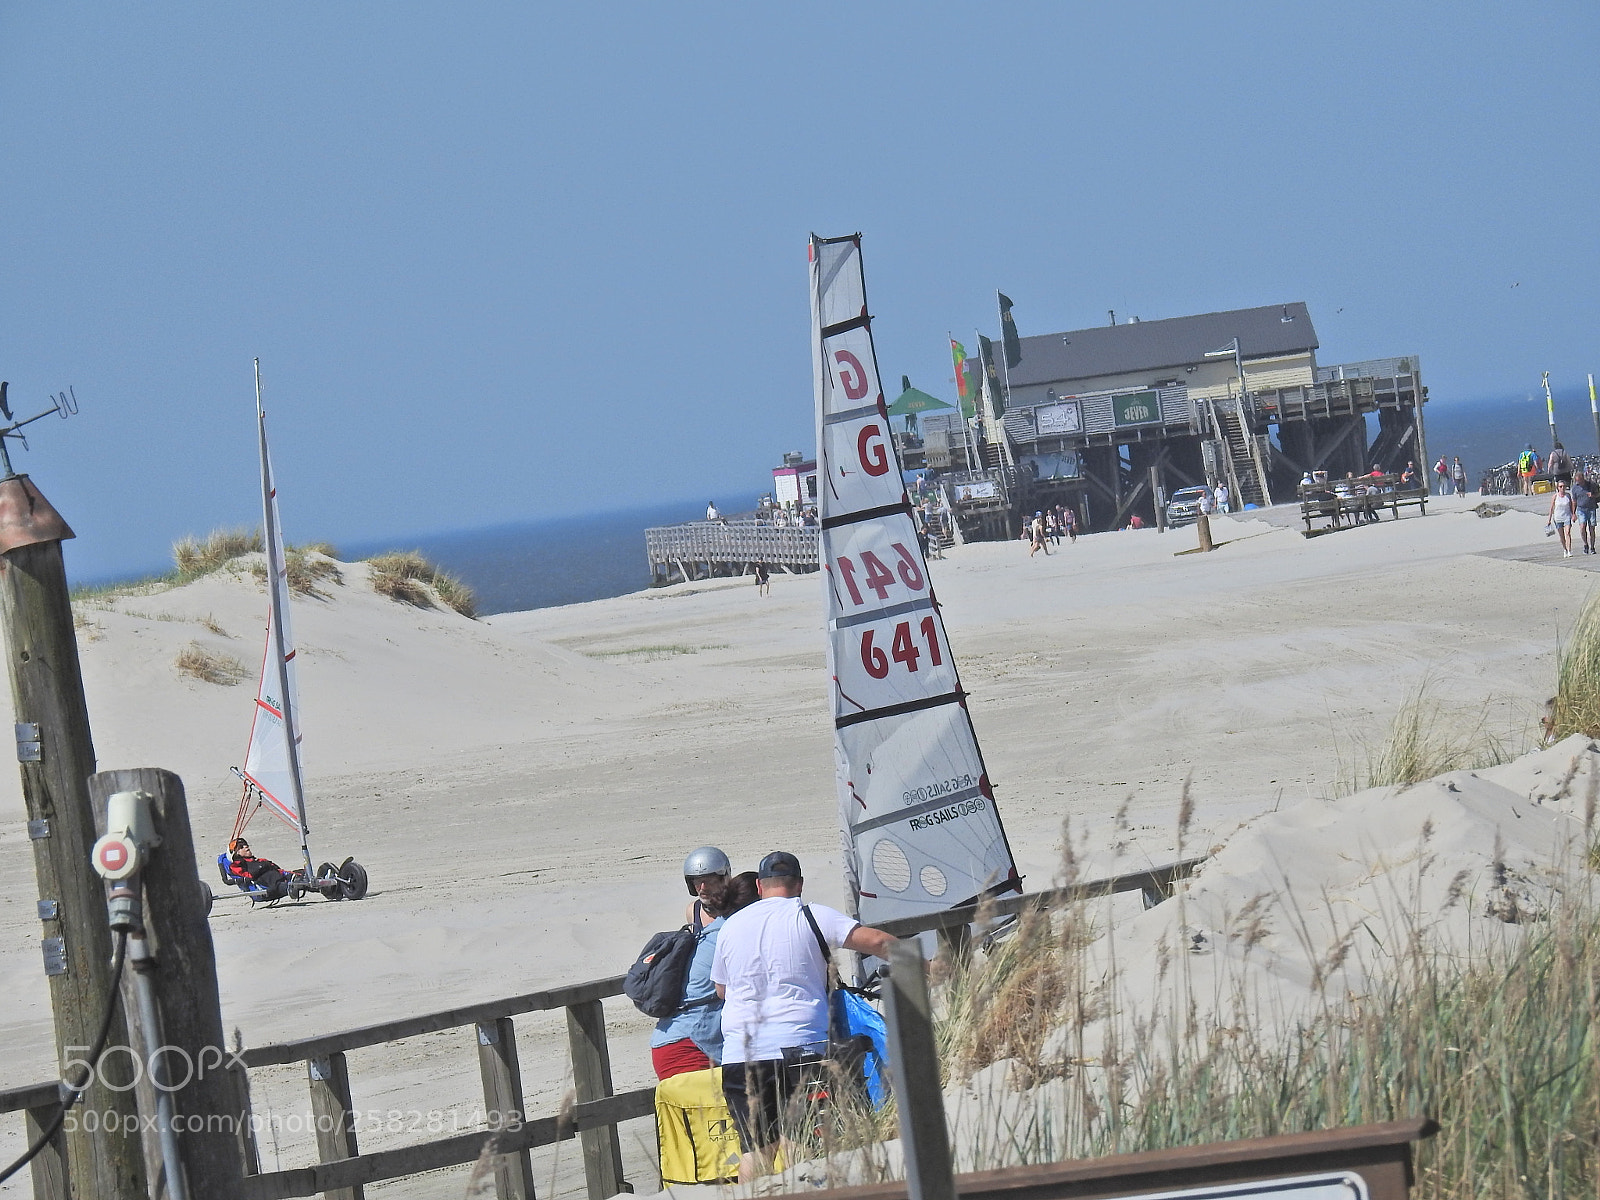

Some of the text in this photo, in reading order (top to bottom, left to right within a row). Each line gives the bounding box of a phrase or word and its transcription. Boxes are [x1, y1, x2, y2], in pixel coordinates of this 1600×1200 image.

[1123, 405, 1149, 420] JEVER
[857, 424, 890, 477] G
[860, 615, 942, 679] 641
[933, 806, 959, 825] SAILS
